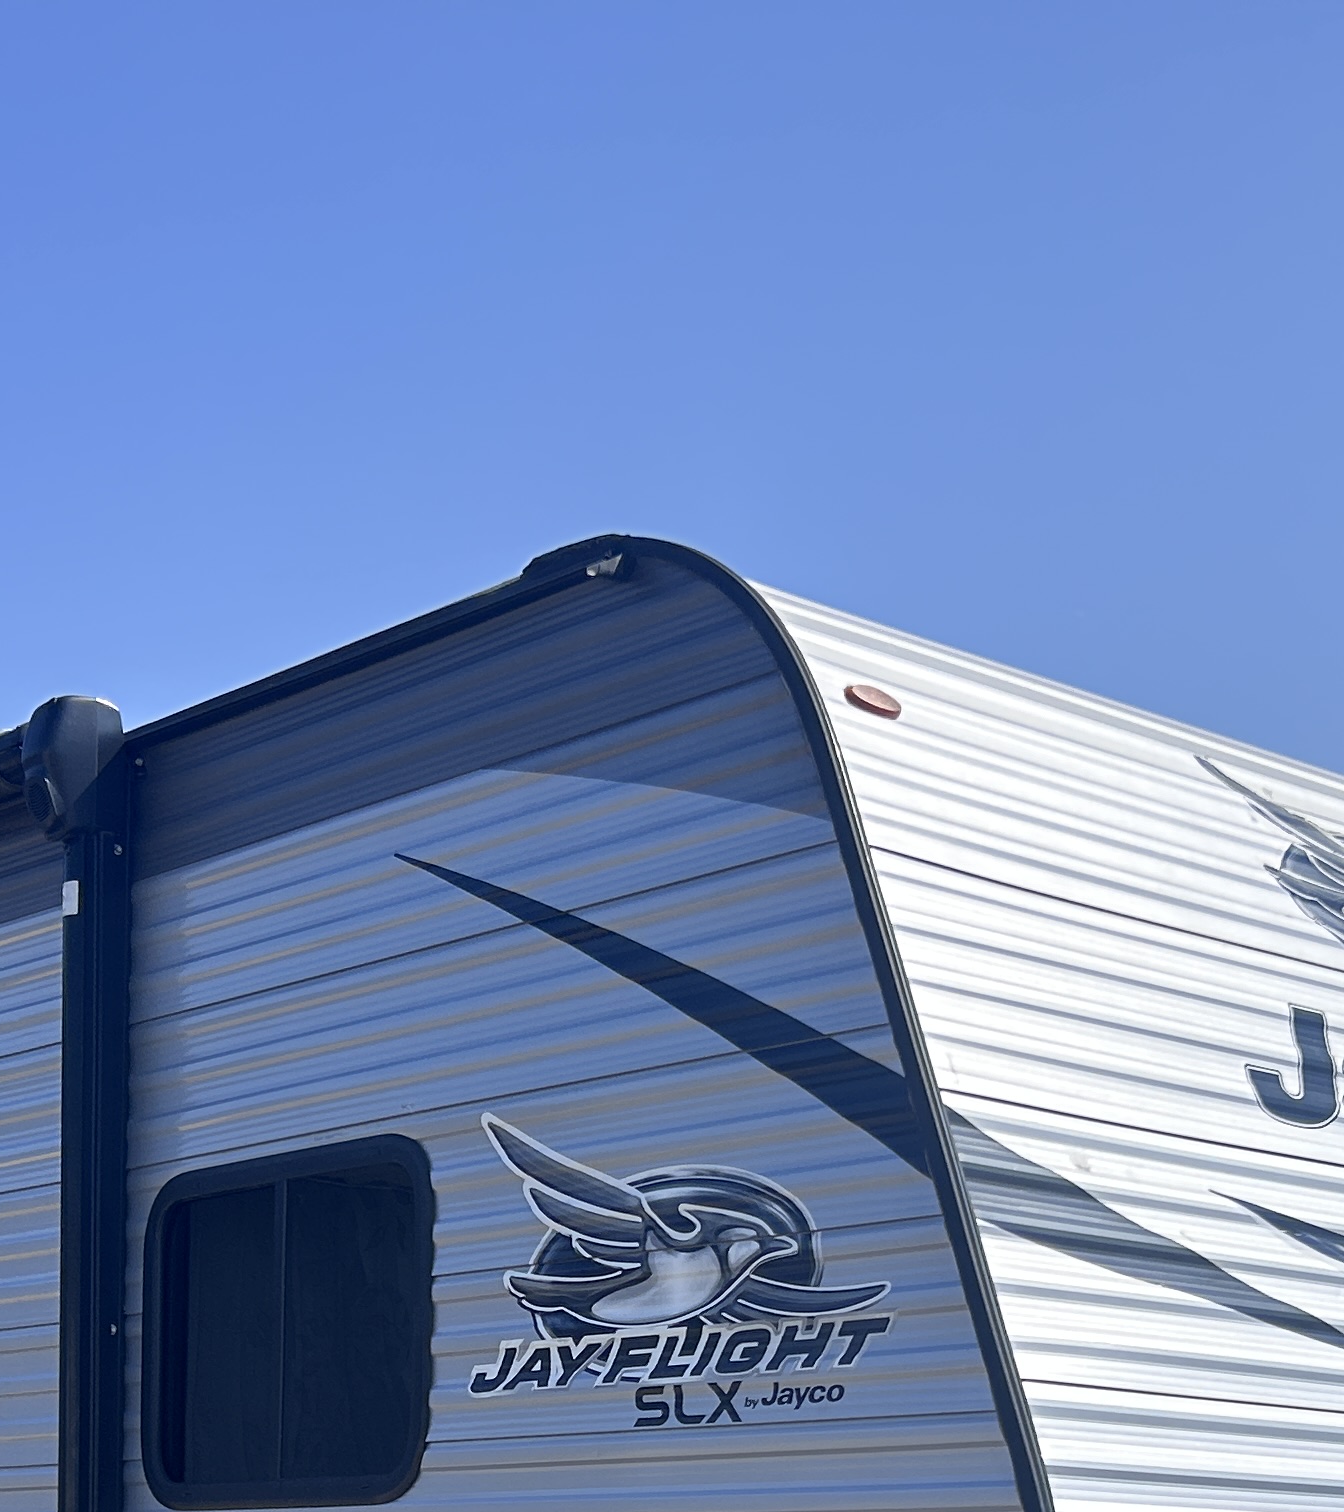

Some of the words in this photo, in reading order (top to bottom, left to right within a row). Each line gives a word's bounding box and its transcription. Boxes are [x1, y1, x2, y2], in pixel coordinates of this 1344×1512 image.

[634, 1380, 743, 1427] SLX
[744, 1397, 759, 1410] by
[761, 1382, 845, 1410] Jayco
